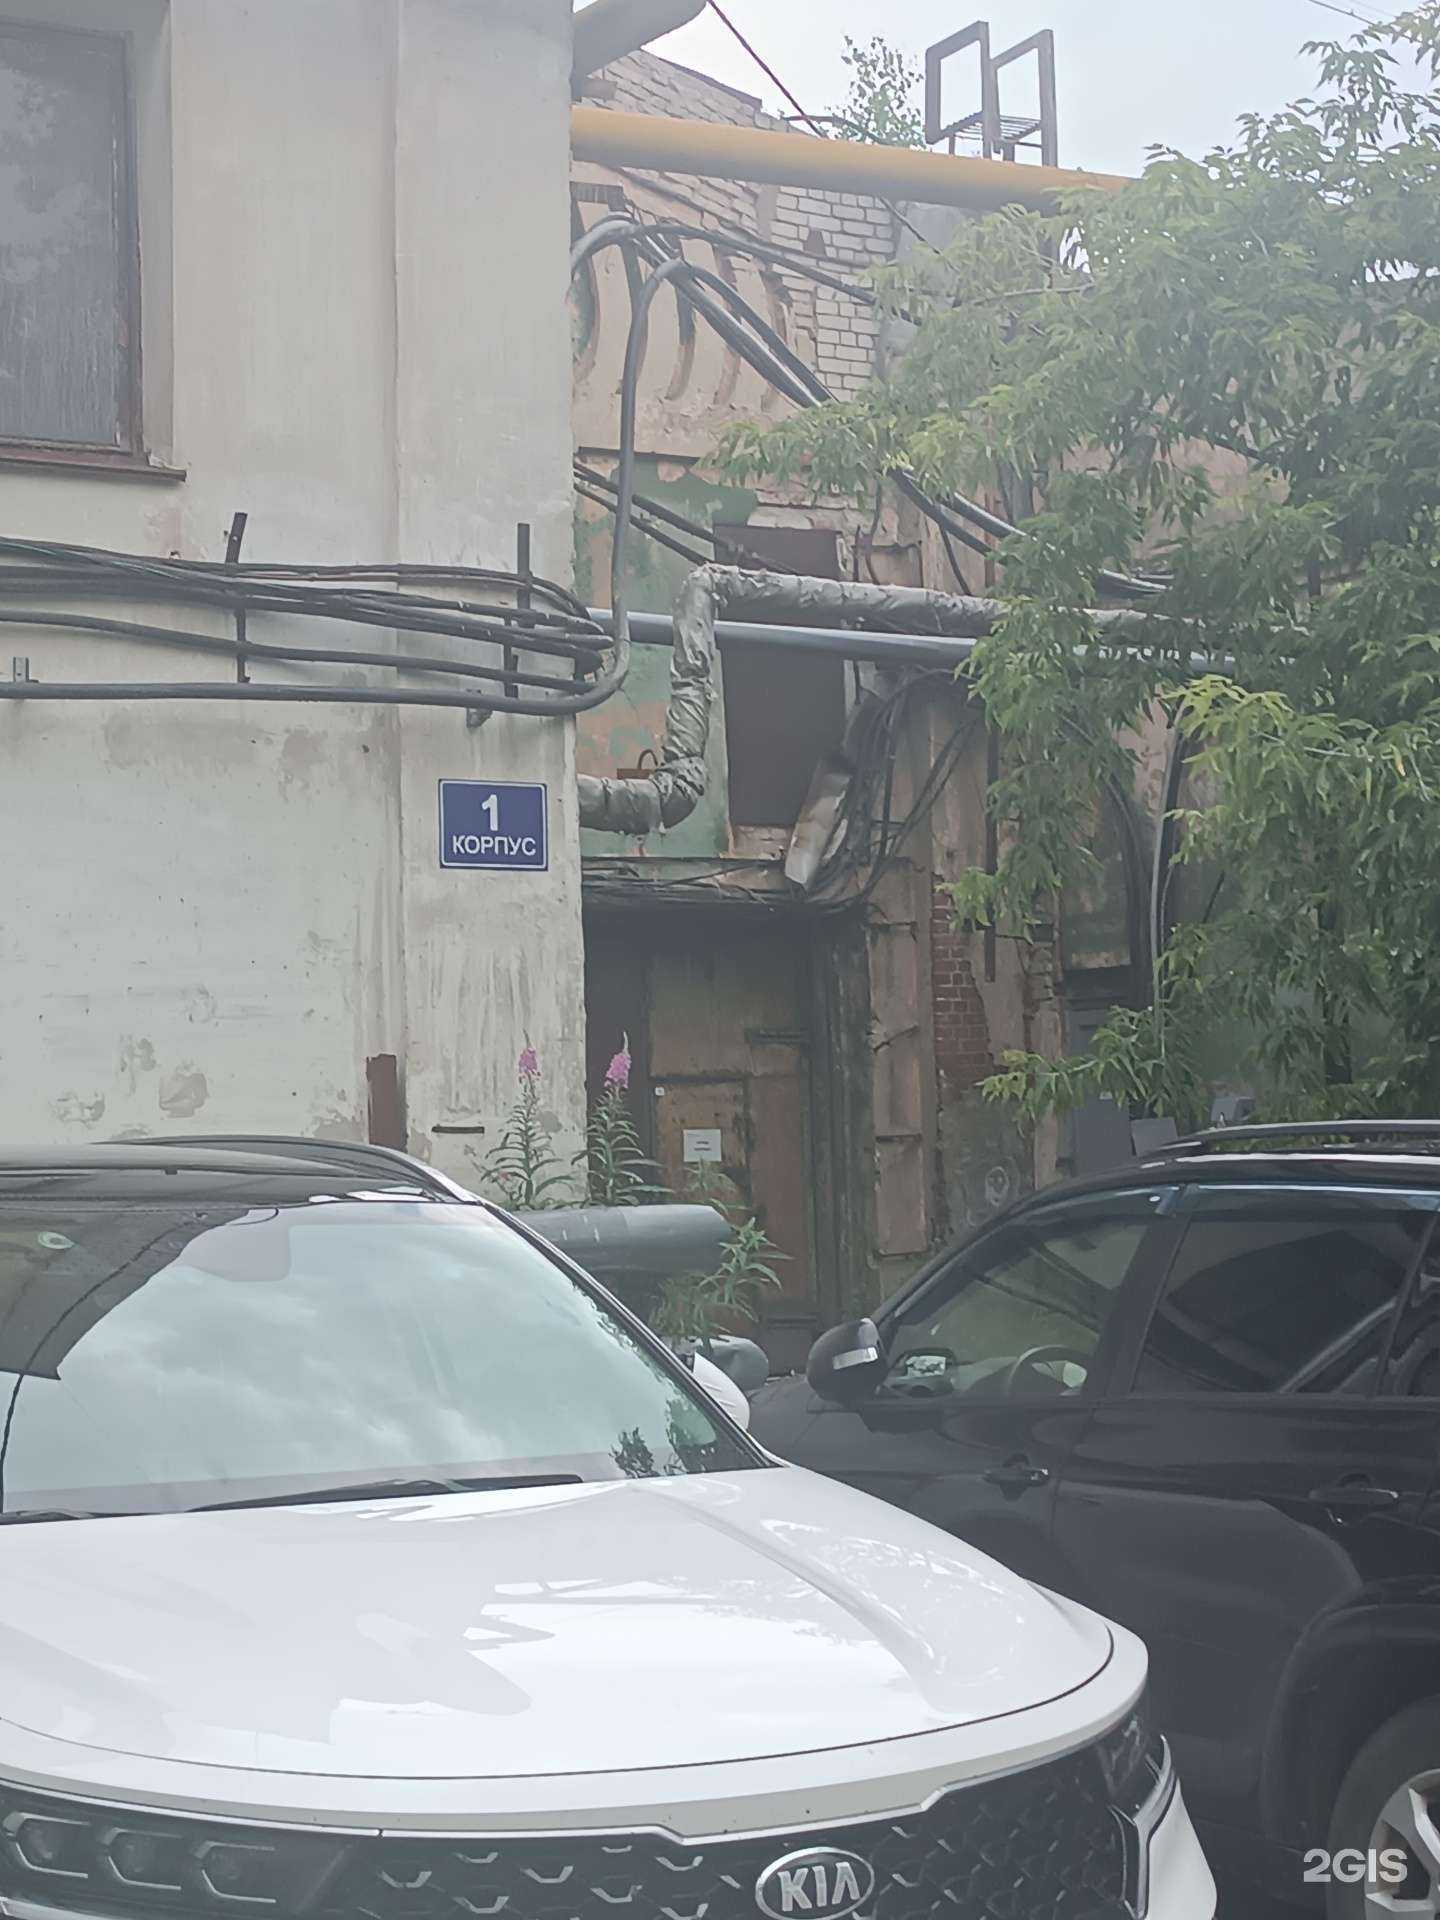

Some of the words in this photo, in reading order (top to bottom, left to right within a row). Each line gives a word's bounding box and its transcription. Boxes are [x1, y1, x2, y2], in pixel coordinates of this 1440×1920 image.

[481, 794, 498, 831] 1
[452, 835, 537, 856] КОРПУС
[777, 1861, 861, 1912] KIA
